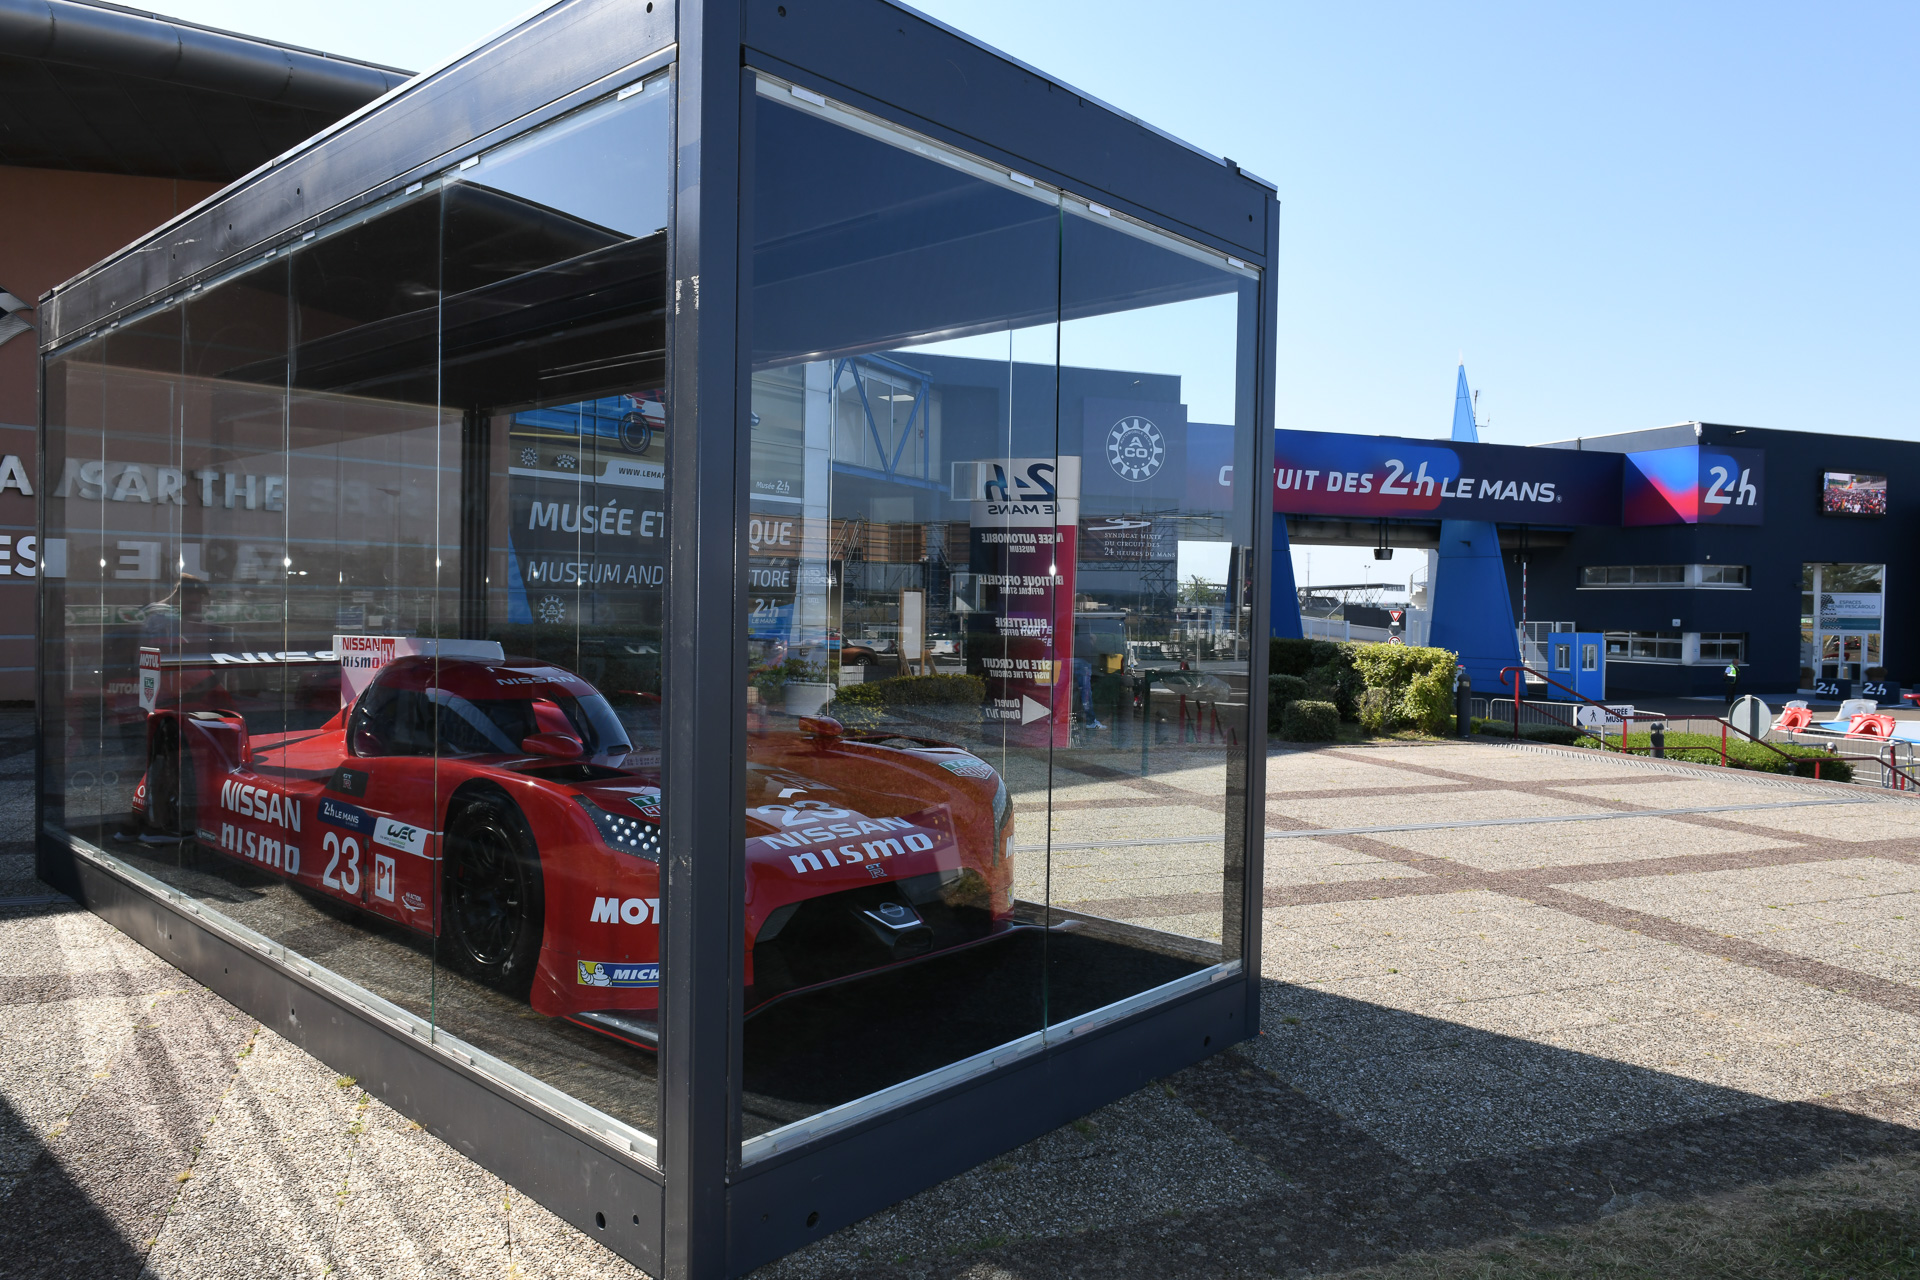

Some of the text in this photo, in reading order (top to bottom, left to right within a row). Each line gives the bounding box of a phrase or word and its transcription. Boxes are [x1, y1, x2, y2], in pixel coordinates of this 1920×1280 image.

[79, 461, 284, 512] SARTHE
[756, 480, 790, 492] Musée 24h
[1218, 465, 1320, 491] CUIT
[1326, 471, 1374, 494] DES
[1379, 459, 1435, 497] 24h
[1440, 477, 1475, 498] LE
[1704, 466, 1756, 506] 24h
[528, 498, 634, 536] MUSÉE
[1104, 532, 1138, 540] SYNDICAT
[1104, 547, 1114, 556] 24
[526, 560, 790, 588] MUSEUM AND TORE
[752, 598, 778, 618] 24h
[342, 638, 380, 650] NISSAN
[140, 654, 160, 668] MOTUL
[342, 654, 380, 669] nismo
[496, 676, 576, 686] NISSAN
[1816, 682, 1839, 695] 24h
[1863, 682, 1887, 696] 24h
[221, 779, 300, 832] NISSAN
[324, 802, 360, 824] 24h LE MANS
[757, 800, 850, 826] 23
[387, 824, 416, 842] WEC
[760, 816, 914, 850] NISSAN
[221, 822, 300, 876] nismo
[788, 833, 934, 874] nismo
[322, 832, 360, 895] 23
[866, 862, 881, 870] GT
[376, 860, 393, 894] P1
[590, 896, 660, 925] MOT
[613, 969, 660, 980] MICH
